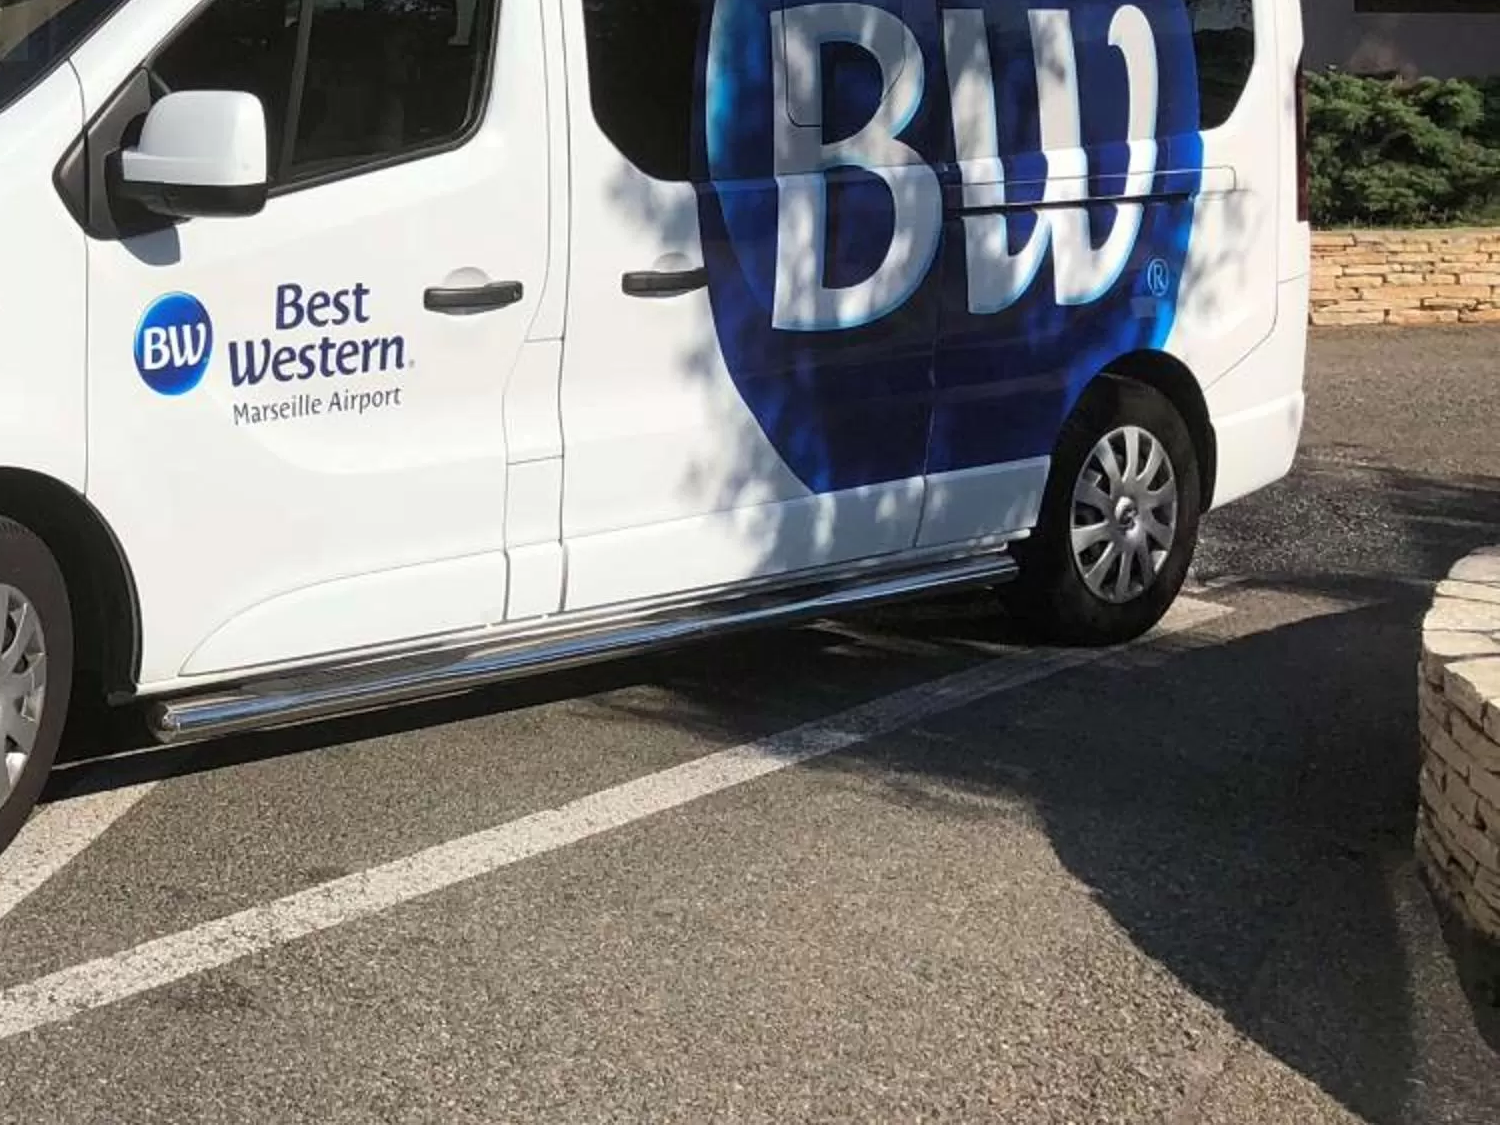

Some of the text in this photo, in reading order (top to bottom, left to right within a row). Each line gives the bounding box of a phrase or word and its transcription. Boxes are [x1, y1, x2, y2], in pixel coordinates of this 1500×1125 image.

[768, 2, 1160, 333] BW
[275, 282, 371, 331] Best
[143, 322, 207, 371] BW
[227, 335, 405, 388] Western
[232, 386, 402, 426] Marseille Airport
